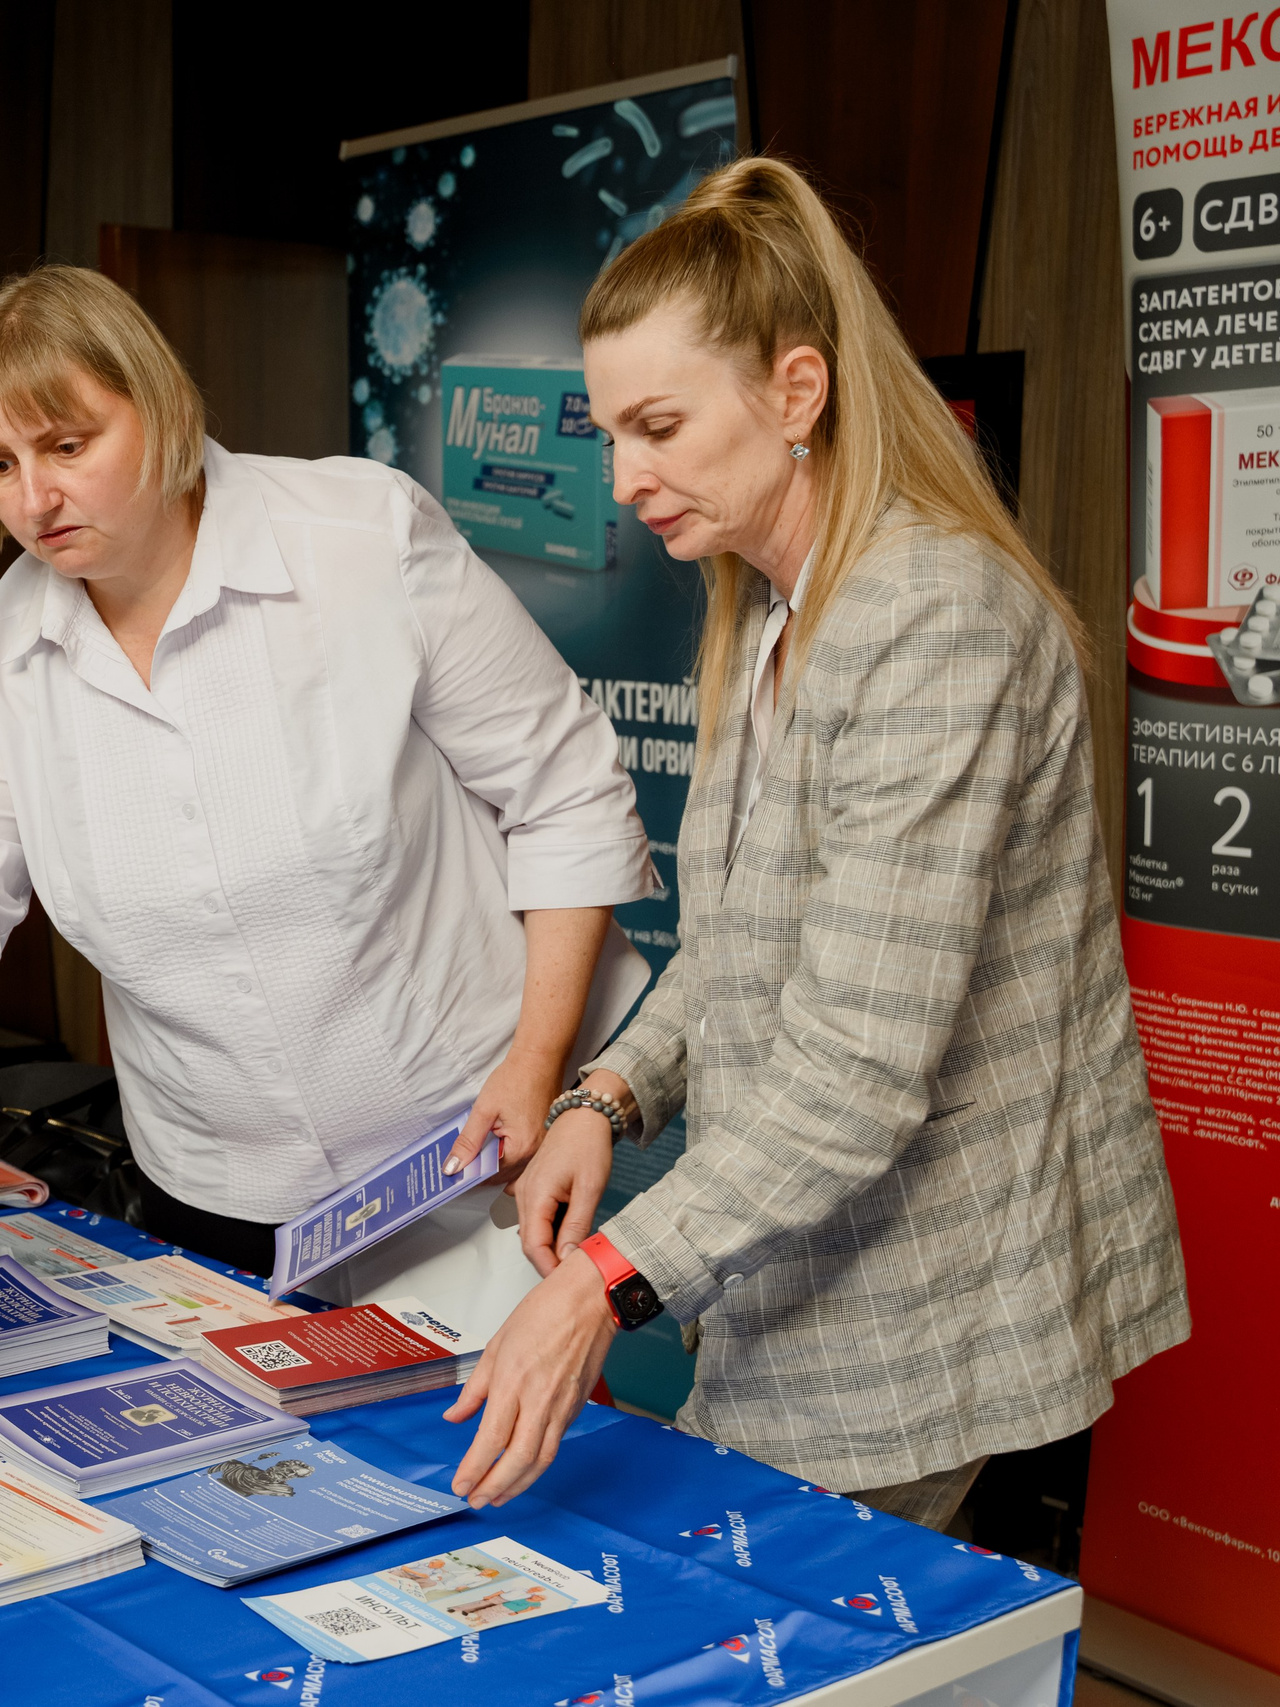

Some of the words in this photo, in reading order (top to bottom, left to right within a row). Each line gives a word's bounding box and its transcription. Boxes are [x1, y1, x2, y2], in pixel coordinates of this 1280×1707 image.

[1133, 97, 1259, 139] БЕРЕЖНАЯ
[1133, 134, 1243, 170] ПОМОЩЬ
[1139, 207, 1171, 241] 6+
[1138, 315, 1210, 343] СХЕМА
[1215, 311, 1278, 336] ЛЕЧЕ
[1138, 349, 1186, 374] СДВГ
[1192, 348, 1207, 369] У
[446, 386, 540, 460] Мунал
[1256, 424, 1273, 438] 50
[1132, 717, 1280, 747] ЭФФЕКТИВНАЯ
[1131, 743, 1215, 771] ТЕРАПИИ
[1222, 753, 1236, 771] С
[1241, 754, 1254, 772] 6
[1137, 777, 1153, 847] 1
[1212, 786, 1252, 858] 2
[1129, 855, 1168, 871] таблетка
[1212, 864, 1240, 878] раза
[1212, 881, 1218, 891] в
[1222, 882, 1258, 896] сутки
[1188, 1034, 1262, 1053] эффективности
[417, 1311, 462, 1338] memo
[186, 1387, 235, 1412] ЖУРНАЛ
[313, 1452, 334, 1464] Reab
[322, 1449, 347, 1464] Neuro
[360, 1473, 452, 1511] www.neuroreab.ru
[725, 1510, 752, 1568] ФАРМАСОФТ
[1138, 1501, 1169, 1522] ООО
[1173, 1515, 1265, 1559] «Векторфарм»,
[502, 1555, 564, 1590] neuroreab.ru
[602, 1552, 623, 1614] ФАРМАСОФТ
[355, 1594, 422, 1632] ИНСУЛЬТ
[754, 1618, 786, 1687] ФАРМАСОФТ
